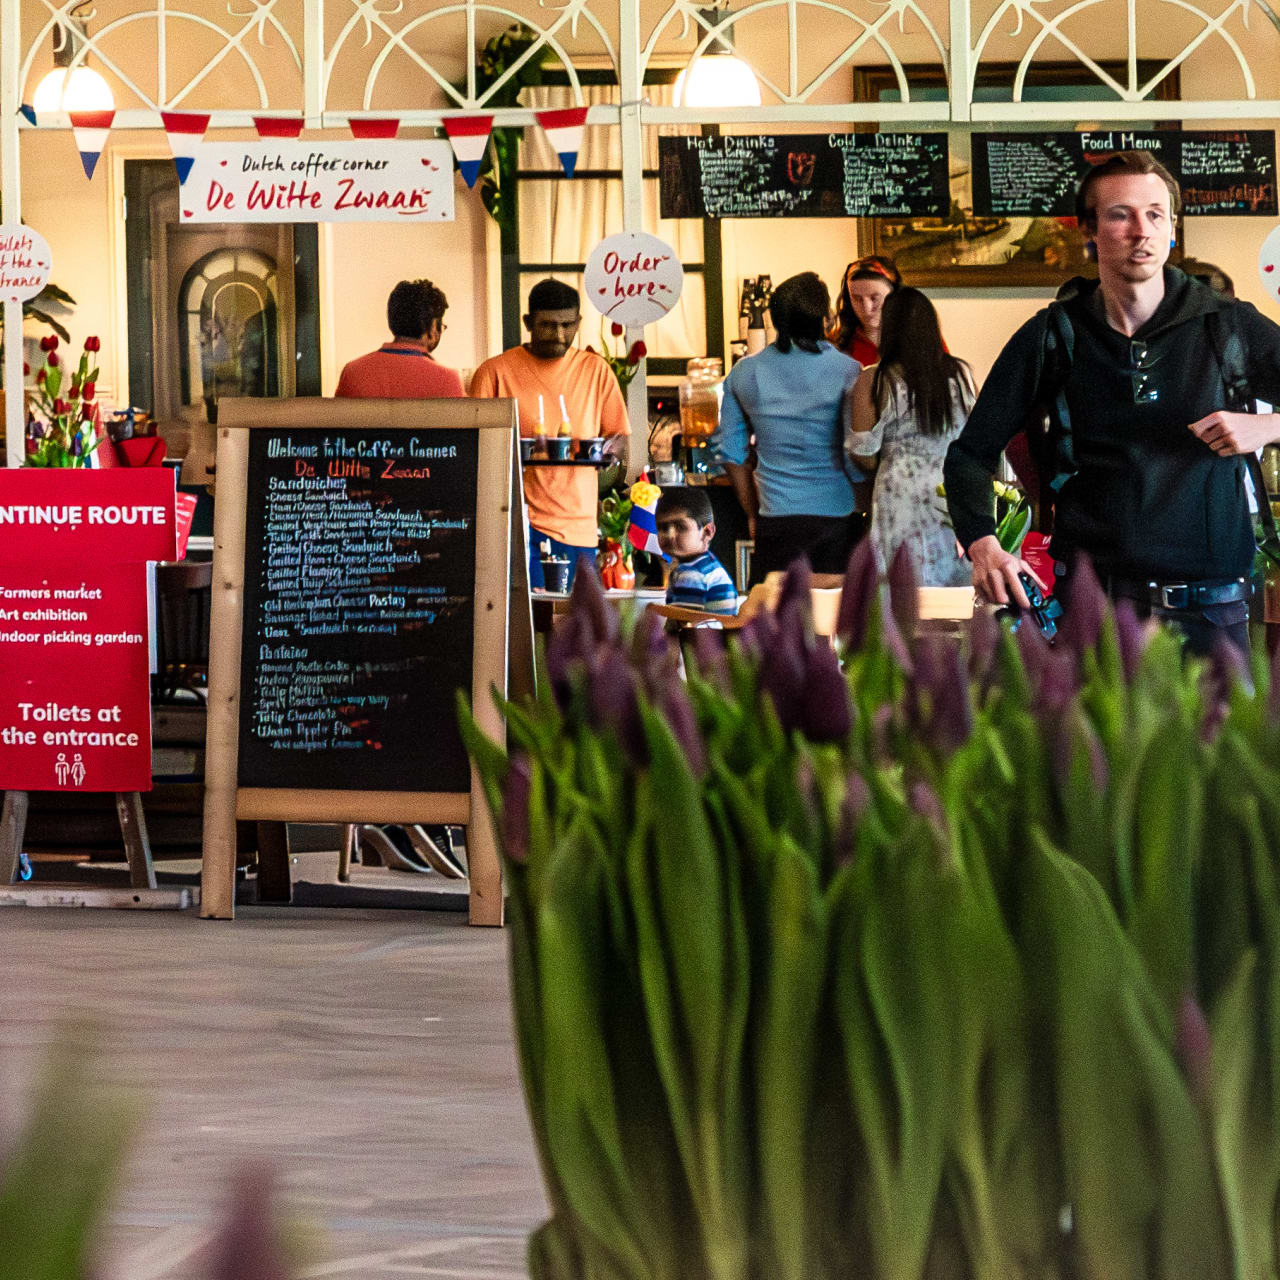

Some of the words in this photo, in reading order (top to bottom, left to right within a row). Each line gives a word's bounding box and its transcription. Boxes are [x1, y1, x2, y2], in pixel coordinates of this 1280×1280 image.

[686, 134, 714, 150] Hot
[828, 133, 857, 149] Cold
[1080, 132, 1115, 150] Food
[241, 153, 286, 172] Dutch
[290, 152, 341, 177] coffee
[343, 159, 390, 172] corner
[206, 180, 235, 211] De
[246, 179, 323, 210] Witte
[333, 178, 430, 212] Zwaan
[12, 252, 33, 269] the
[603, 250, 662, 275] Order
[614, 276, 657, 298] here
[266, 437, 318, 458] Welcome
[335, 437, 356, 457] the
[295, 459, 316, 478] De
[268, 476, 347, 490] Sandwiches
[88, 506, 166, 525] ROUTE
[54, 584, 102, 600] market
[22, 608, 88, 621] exhibition
[43, 630, 91, 646] picking
[95, 633, 143, 645] garden
[17, 702, 91, 722] Toilets
[97, 704, 121, 722] at
[1, 727, 37, 745] the
[42, 729, 139, 746] entrance
